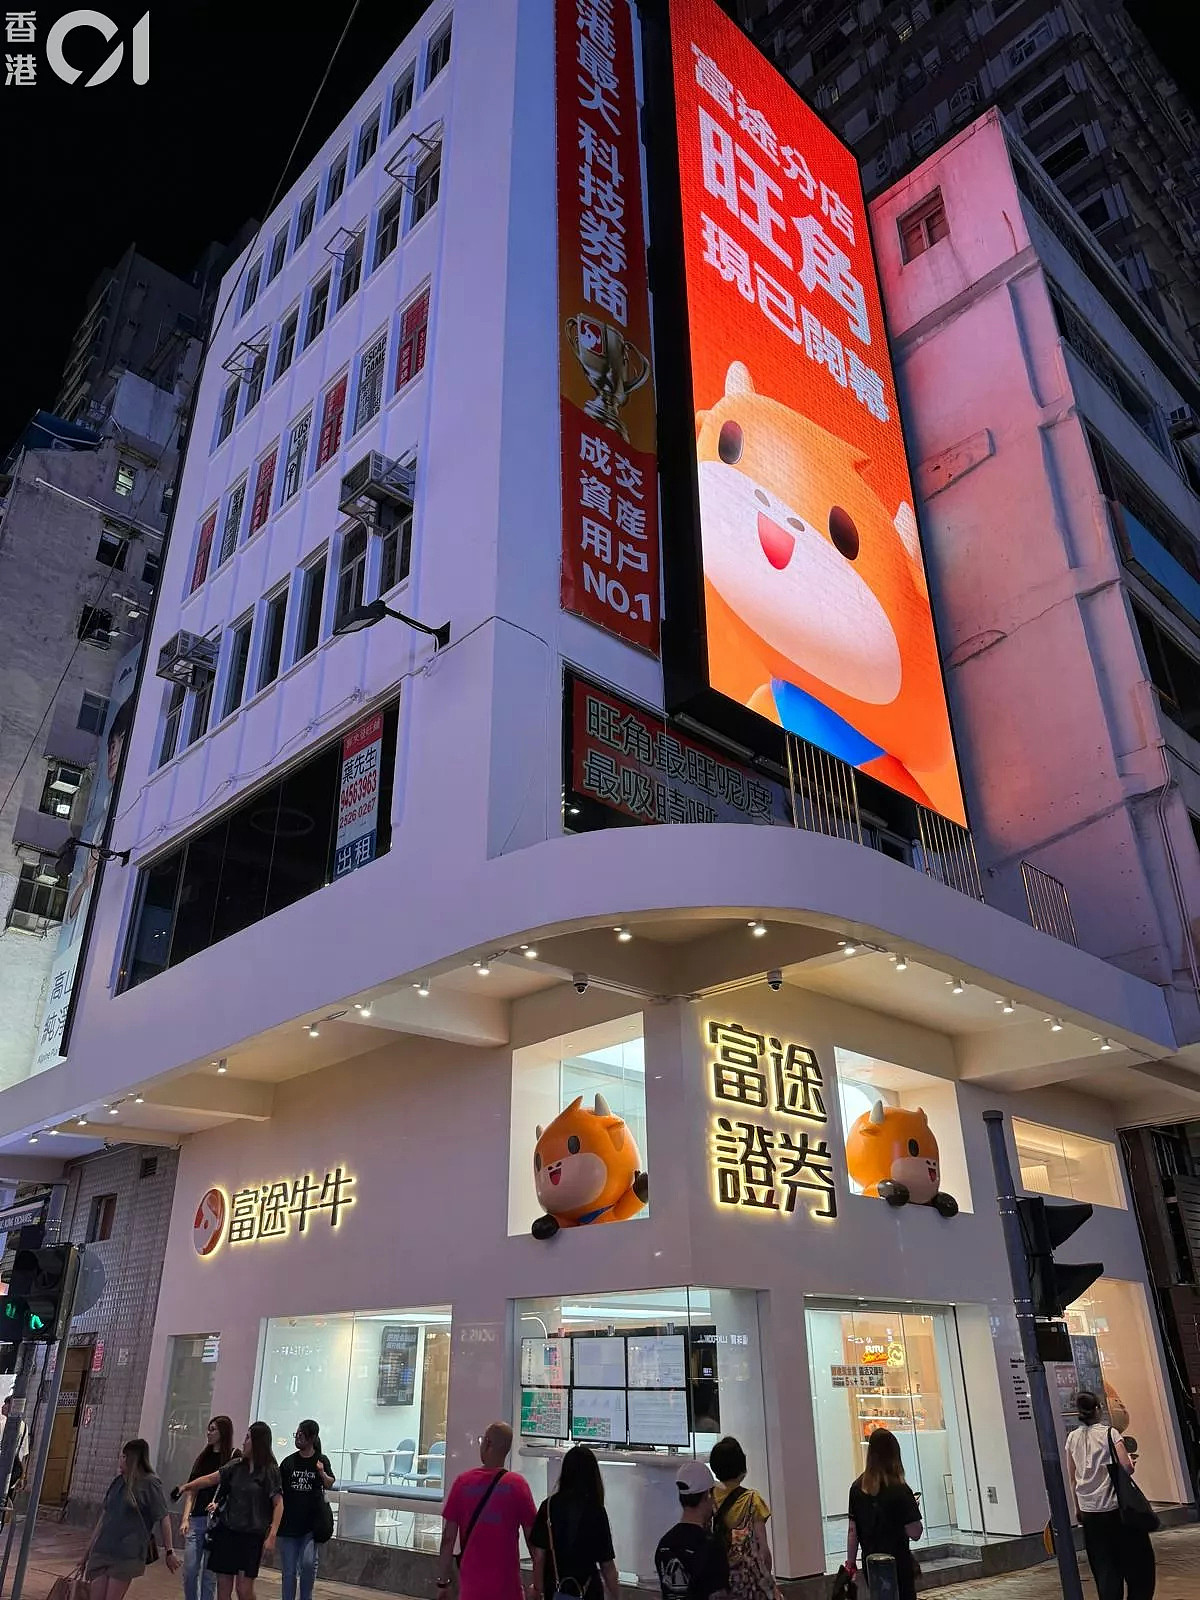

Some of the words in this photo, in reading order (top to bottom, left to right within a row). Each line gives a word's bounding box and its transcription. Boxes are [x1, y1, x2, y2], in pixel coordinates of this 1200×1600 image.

[575, 0, 629, 327] 港最大科技券商
[690, 41, 857, 247] 富途分店
[698, 104, 872, 346] 旺角
[700, 211, 890, 424] 現已開幕
[580, 431, 644, 500] 成交
[580, 468, 649, 541] 資產
[581, 516, 649, 574] 用戶
[583, 560, 652, 623] NO.1
[585, 694, 773, 825] 旺角最旺呢度
[336, 836, 372, 875] 出租
[708, 1020, 828, 1124] 富途
[228, 1166, 353, 1244] 富途牛牛
[715, 1117, 838, 1219] 證券
